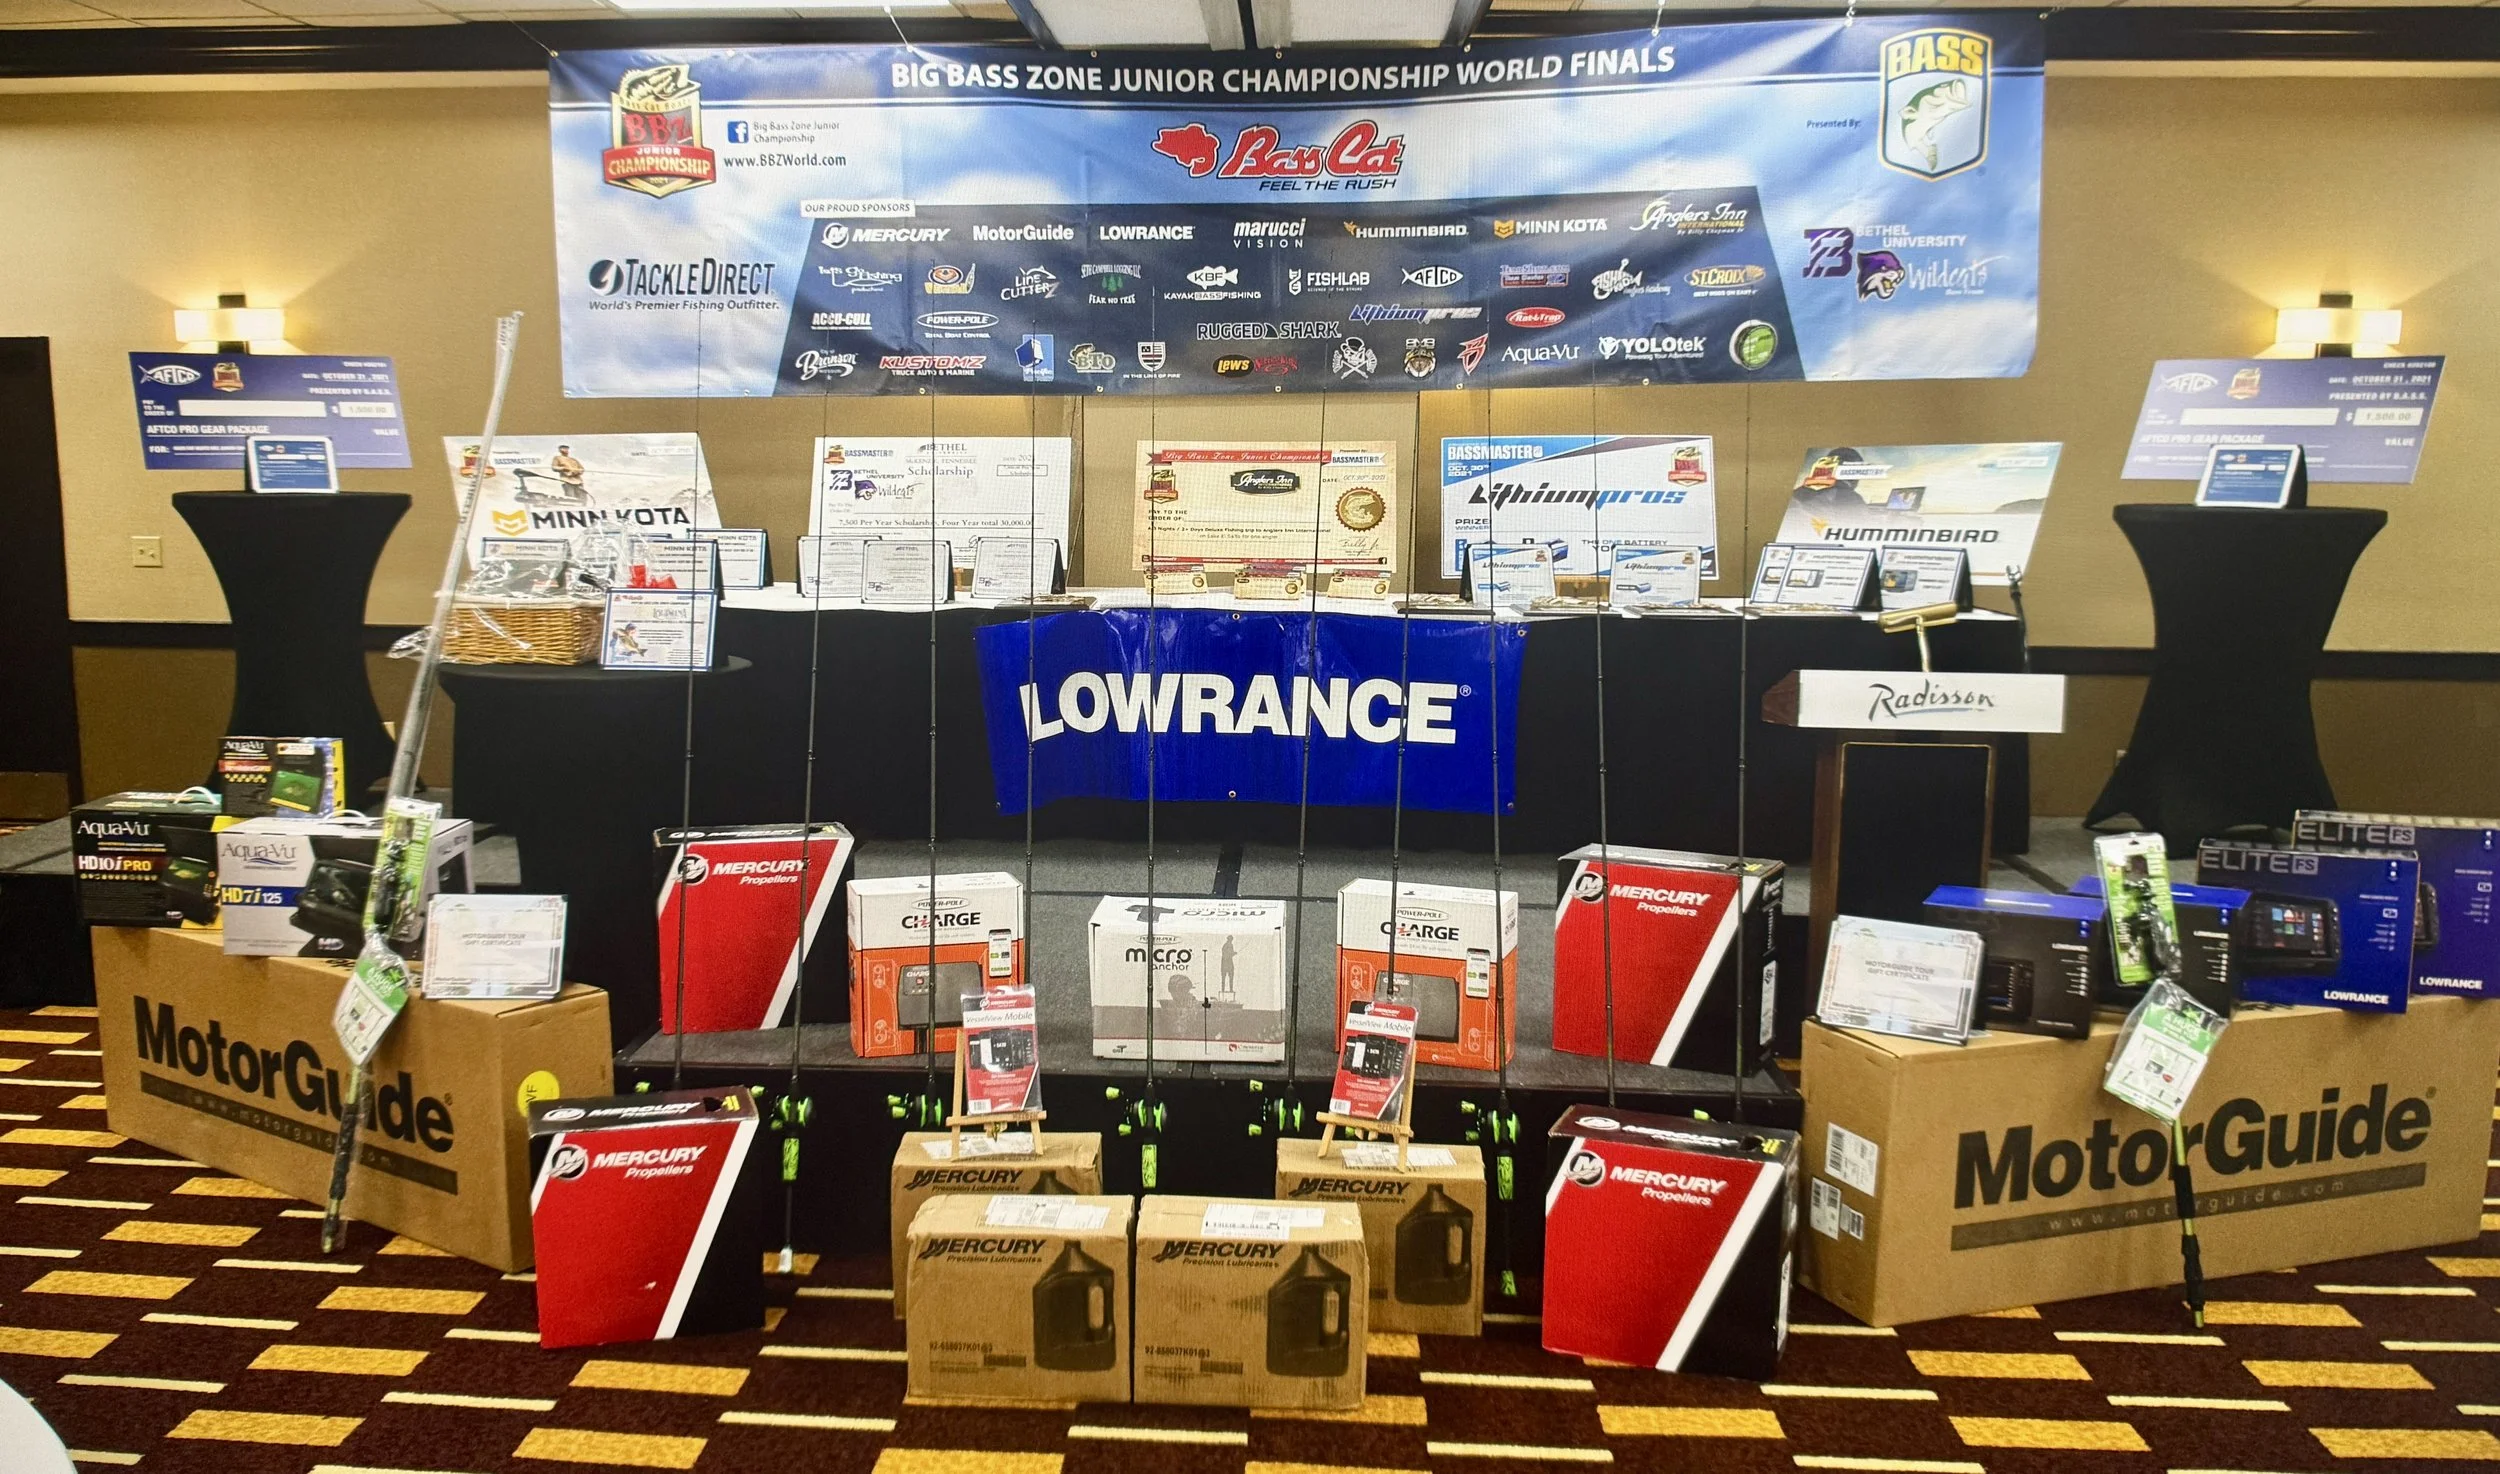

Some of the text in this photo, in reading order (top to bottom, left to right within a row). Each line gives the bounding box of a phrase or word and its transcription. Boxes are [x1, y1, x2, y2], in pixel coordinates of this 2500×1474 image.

[1890, 35, 1984, 77] BASS
[891, 46, 1675, 94] BIG BASS ZONE JUNIOR CHAMPIONSHIP WORLD FINALS
[753, 121, 840, 132] Big Bass Zone Junior
[1806, 119, 1848, 129] Presented
[753, 134, 815, 144] Championship
[636, 146, 681, 155] JUNIOR
[1218, 119, 1405, 179] Bass Cat
[608, 156, 711, 177] CHAMPIONSHIP
[723, 154, 847, 168] www.BBZWorld.com
[1259, 178, 1397, 192] FEEL THE RUSH
[805, 203, 911, 213] OUR PROUD SPONSORS
[1711, 202, 1748, 221] Inn
[853, 224, 1194, 243] MERCURY MotorGuide LOWRANCE
[1233, 217, 1307, 237] marucci
[1356, 224, 1468, 239] HUMMINBIRD
[1515, 218, 1608, 234] MINN KOTA
[1854, 224, 1910, 236] BETHEL
[1233, 239, 1303, 248] VISION
[1883, 235, 1967, 248] UNIVERSITY
[1193, 272, 1224, 282] KBF
[1307, 272, 1370, 286] FISHLAB
[1908, 255, 2011, 291] Wildcats
[589, 300, 780, 311] World's Premier Fishing Outfitter.
[1089, 294, 1106, 304] FEAR
[812, 312, 871, 326] ACCU-CULL
[926, 315, 989, 325] POWER-POLE
[1197, 322, 1342, 340] RUGGED SHARK
[1622, 336, 1706, 352] YOLOtek
[1502, 343, 1580, 364] Aqua-Vu
[795, 350, 857, 381] Branson
[879, 355, 987, 369] KUSTOMZ
[2329, 392, 2391, 400] PRESENTED BY
[146, 425, 270, 434] AFTCO PRO GEAR PACKAGE
[2192, 434, 2218, 443] GEAR
[2219, 434, 2265, 443] PACKAGE
[2385, 438, 2415, 447] VALUE
[926, 443, 967, 451] BETHEL
[1448, 445, 1533, 460] BASSMASTER
[1165, 452, 1330, 463] Big Championship
[1332, 455, 1374, 464] BASSMASTER
[908, 465, 974, 479] Scholarship
[1468, 482, 1687, 511] Lithiumpros
[531, 507, 691, 530] MINN KOTA
[1825, 528, 1999, 543] HUMMINBIRD
[1868, 678, 1995, 722] Radisson
[1018, 672, 1458, 744] LOWRANCE
[224, 740, 265, 752] Aqua-Vu
[77, 821, 151, 838] Aqua-Vu
[2299, 822, 2413, 844] ELITE FS
[221, 843, 296, 861] Aqua-Vu
[123, 860, 152, 871] PRO
[712, 858, 811, 876] MERCURY
[2201, 851, 2316, 874] ELITE FS
[740, 875, 798, 886] Propellers
[262, 892, 282, 904] 125
[1610, 884, 1712, 906] MERCURY
[1397, 909, 1443, 918] POWER-POLE
[1637, 901, 1697, 917] Propellers
[901, 912, 981, 929] CHARGE
[1125, 948, 1193, 963] mcro
[1865, 960, 1934, 974] MOTORGUIDE TOUR
[2420, 976, 2483, 990] LOWRANCE
[2324, 990, 2389, 1004] LOWRANCE
[1004, 1011, 1034, 1021] Mobile
[1383, 1022, 1412, 1033] Mobile
[588, 1102, 701, 1117] MERCURY
[593, 1146, 707, 1169] MERCURY
[624, 1164, 694, 1180] Propellers
[904, 1170, 1024, 1191] MERCURY
[1289, 1177, 1411, 1197] MERCURY
[1610, 1166, 1729, 1194] MERCURY
[1641, 1187, 1712, 1206] Propellers
[918, 1239, 1047, 1260] MERCURY
[1152, 1240, 1285, 1263] MERCURY
[947, 1255, 989, 1263] Precision
[1182, 1257, 1224, 1266] Precision
